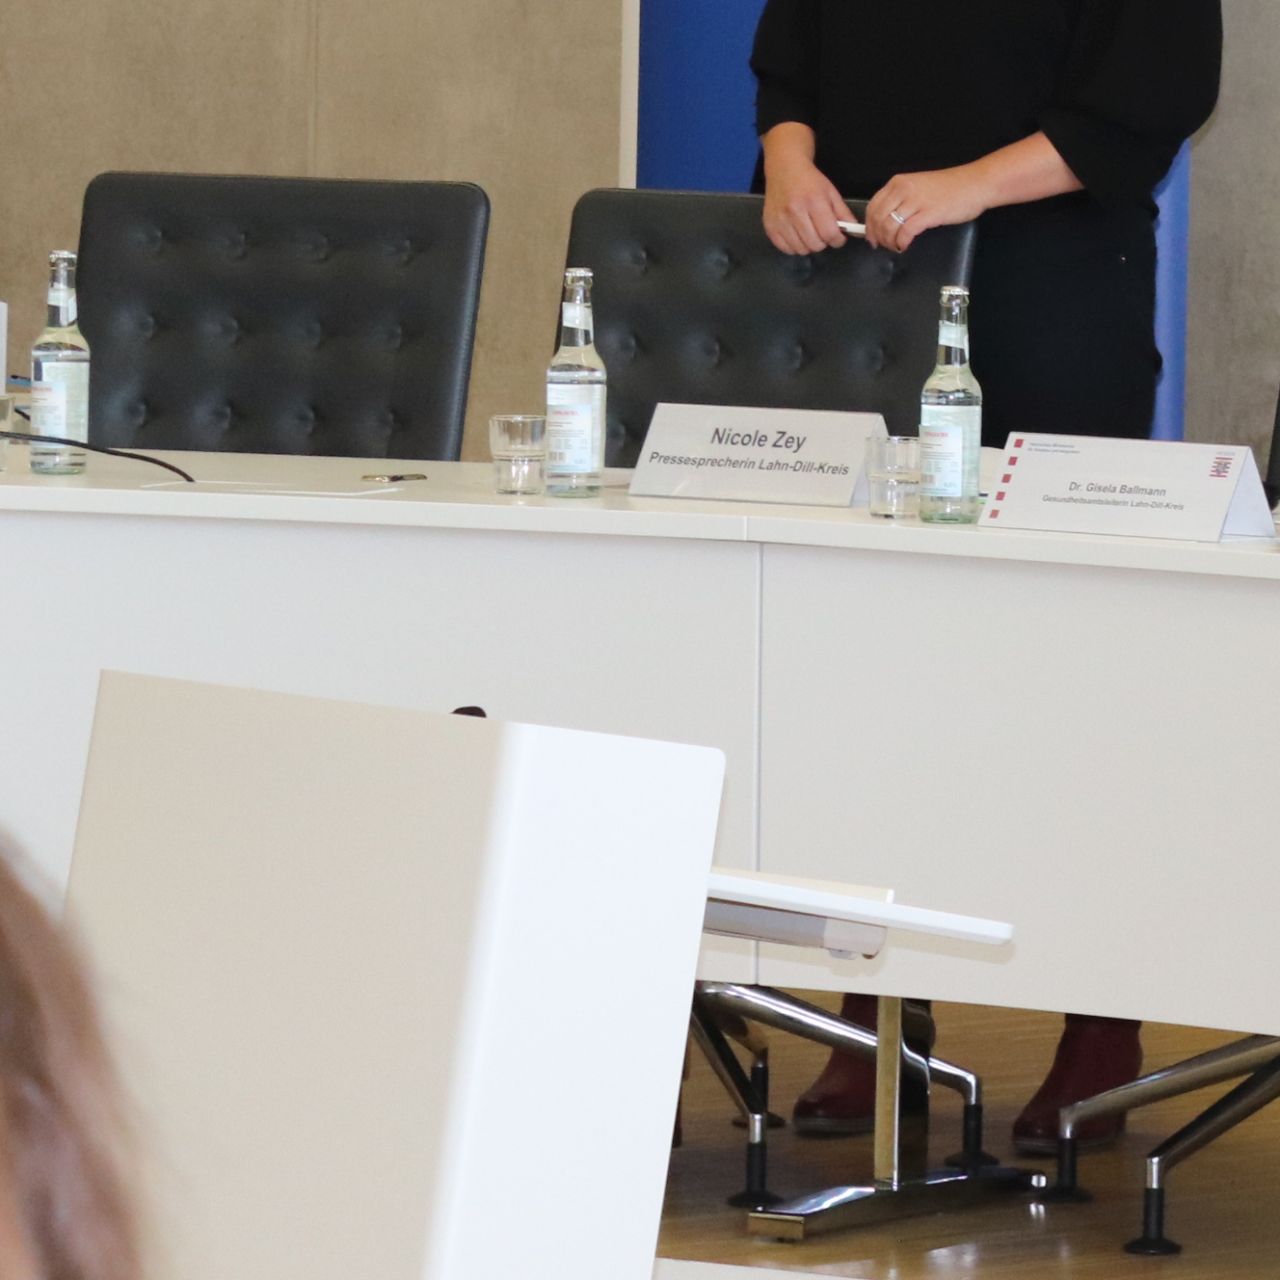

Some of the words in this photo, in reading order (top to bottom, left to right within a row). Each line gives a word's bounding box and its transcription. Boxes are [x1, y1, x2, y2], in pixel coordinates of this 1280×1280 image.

[710, 427, 768, 448] Nicole
[772, 430, 807, 453] Zey
[649, 451, 756, 470] Pressesprecherin
[758, 459, 849, 476] Lahn-Dill-Kreis
[1068, 481, 1082, 492] Dr.
[1086, 483, 1117, 494] Gisela
[1119, 484, 1167, 497] Ballmann
